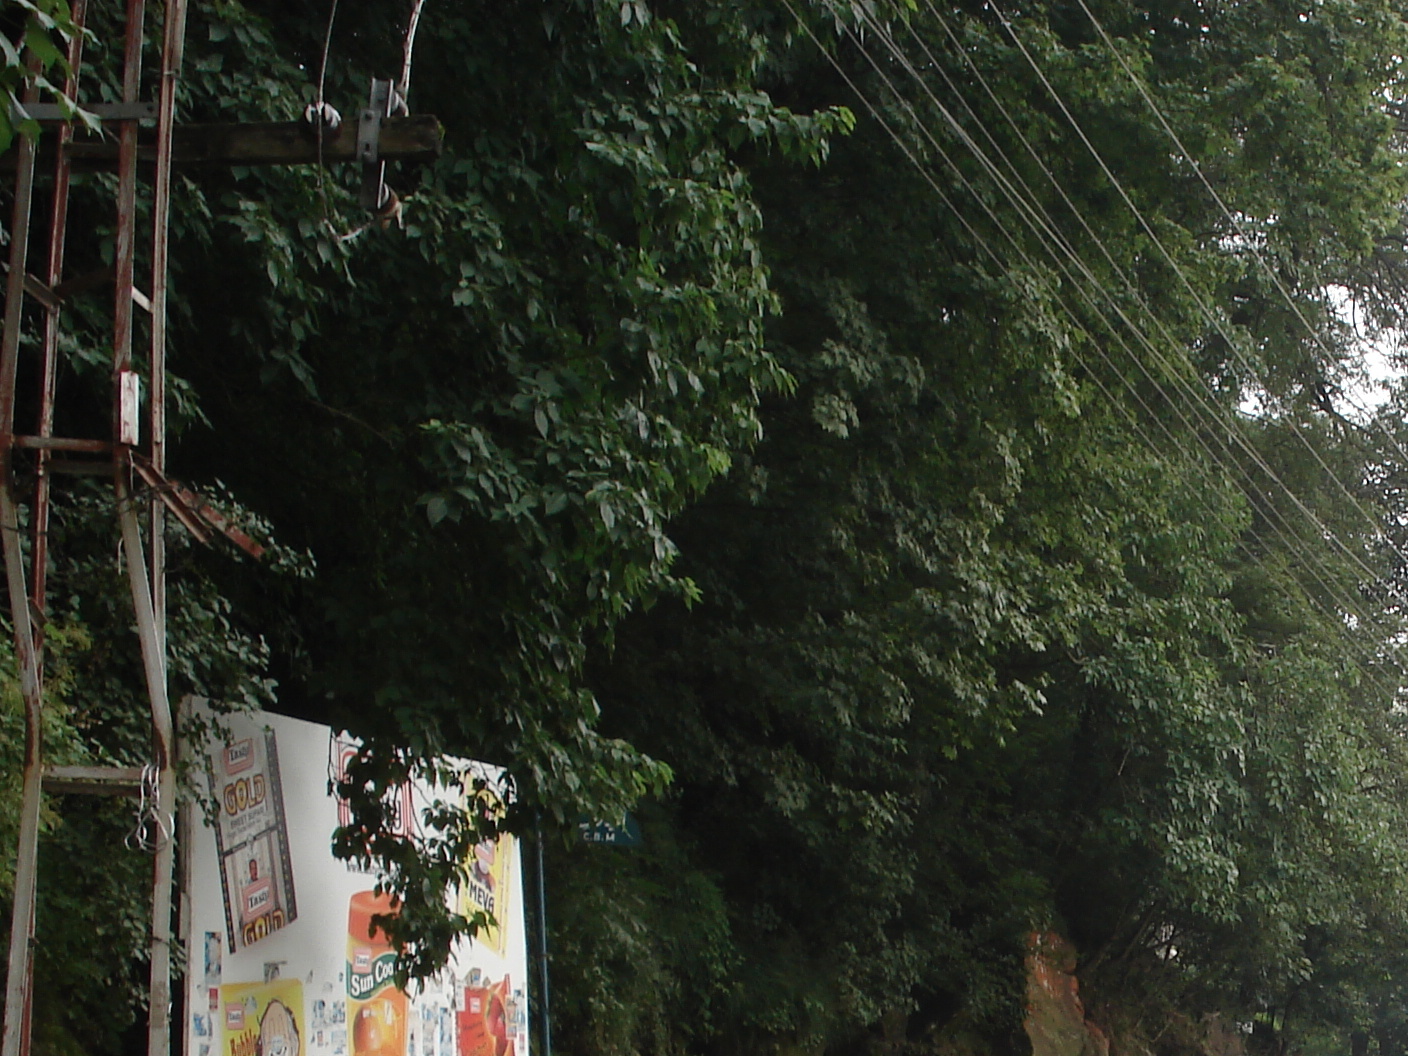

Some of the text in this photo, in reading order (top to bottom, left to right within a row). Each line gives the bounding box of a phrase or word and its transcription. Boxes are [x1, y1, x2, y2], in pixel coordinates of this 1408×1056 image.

[223, 773, 265, 816] GOLD
[351, 960, 394, 997] Sun Coo
